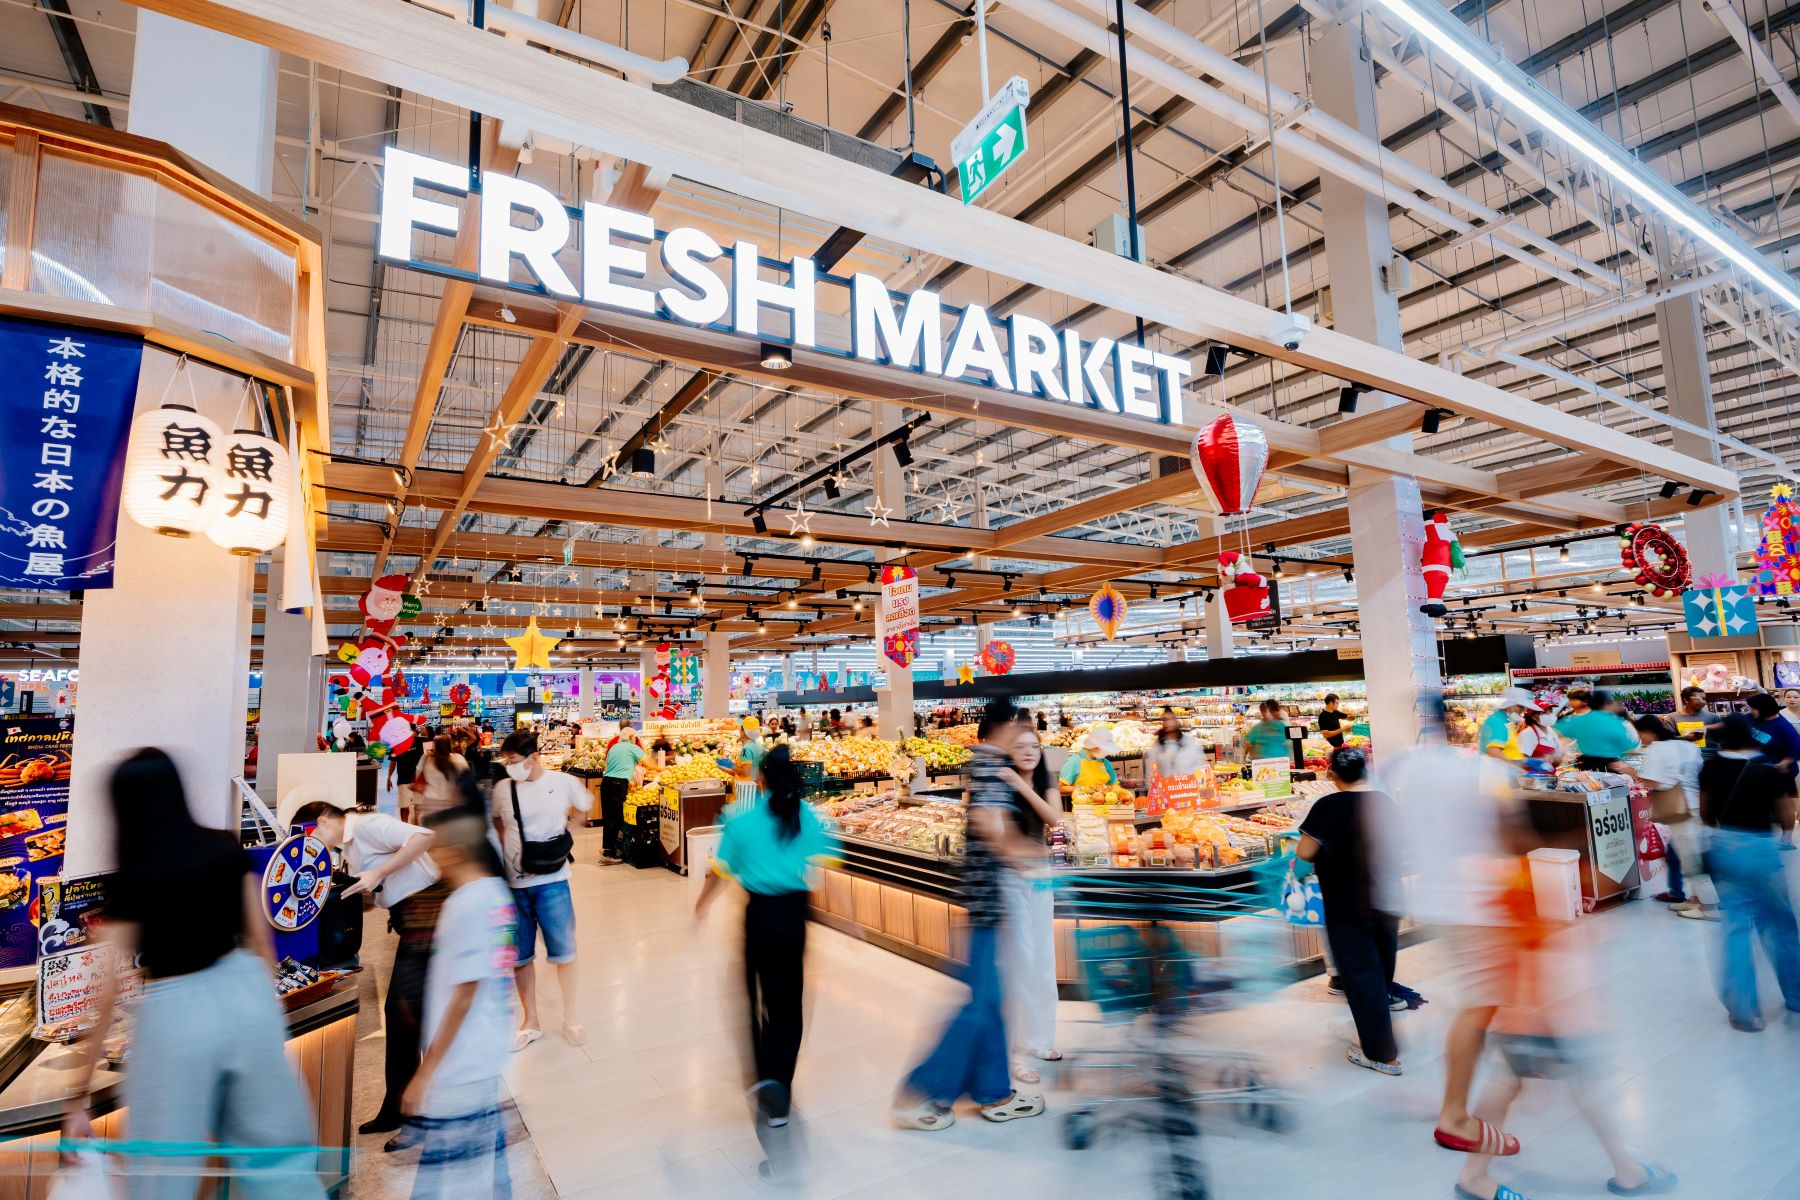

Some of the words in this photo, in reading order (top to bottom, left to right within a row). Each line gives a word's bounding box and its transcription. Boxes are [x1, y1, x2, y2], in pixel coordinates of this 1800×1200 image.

[379, 146, 816, 347] FRESH
[850, 272, 1191, 425] MARKET
[23, 336, 86, 578] 本格的な日本の魚屋
[160, 421, 212, 506] 魚力
[224, 443, 275, 520] 魚力
[892, 597, 909, 608] แรง
[1595, 808, 1630, 837] อร่อย!
[65, 881, 103, 896] ปลาไหล
